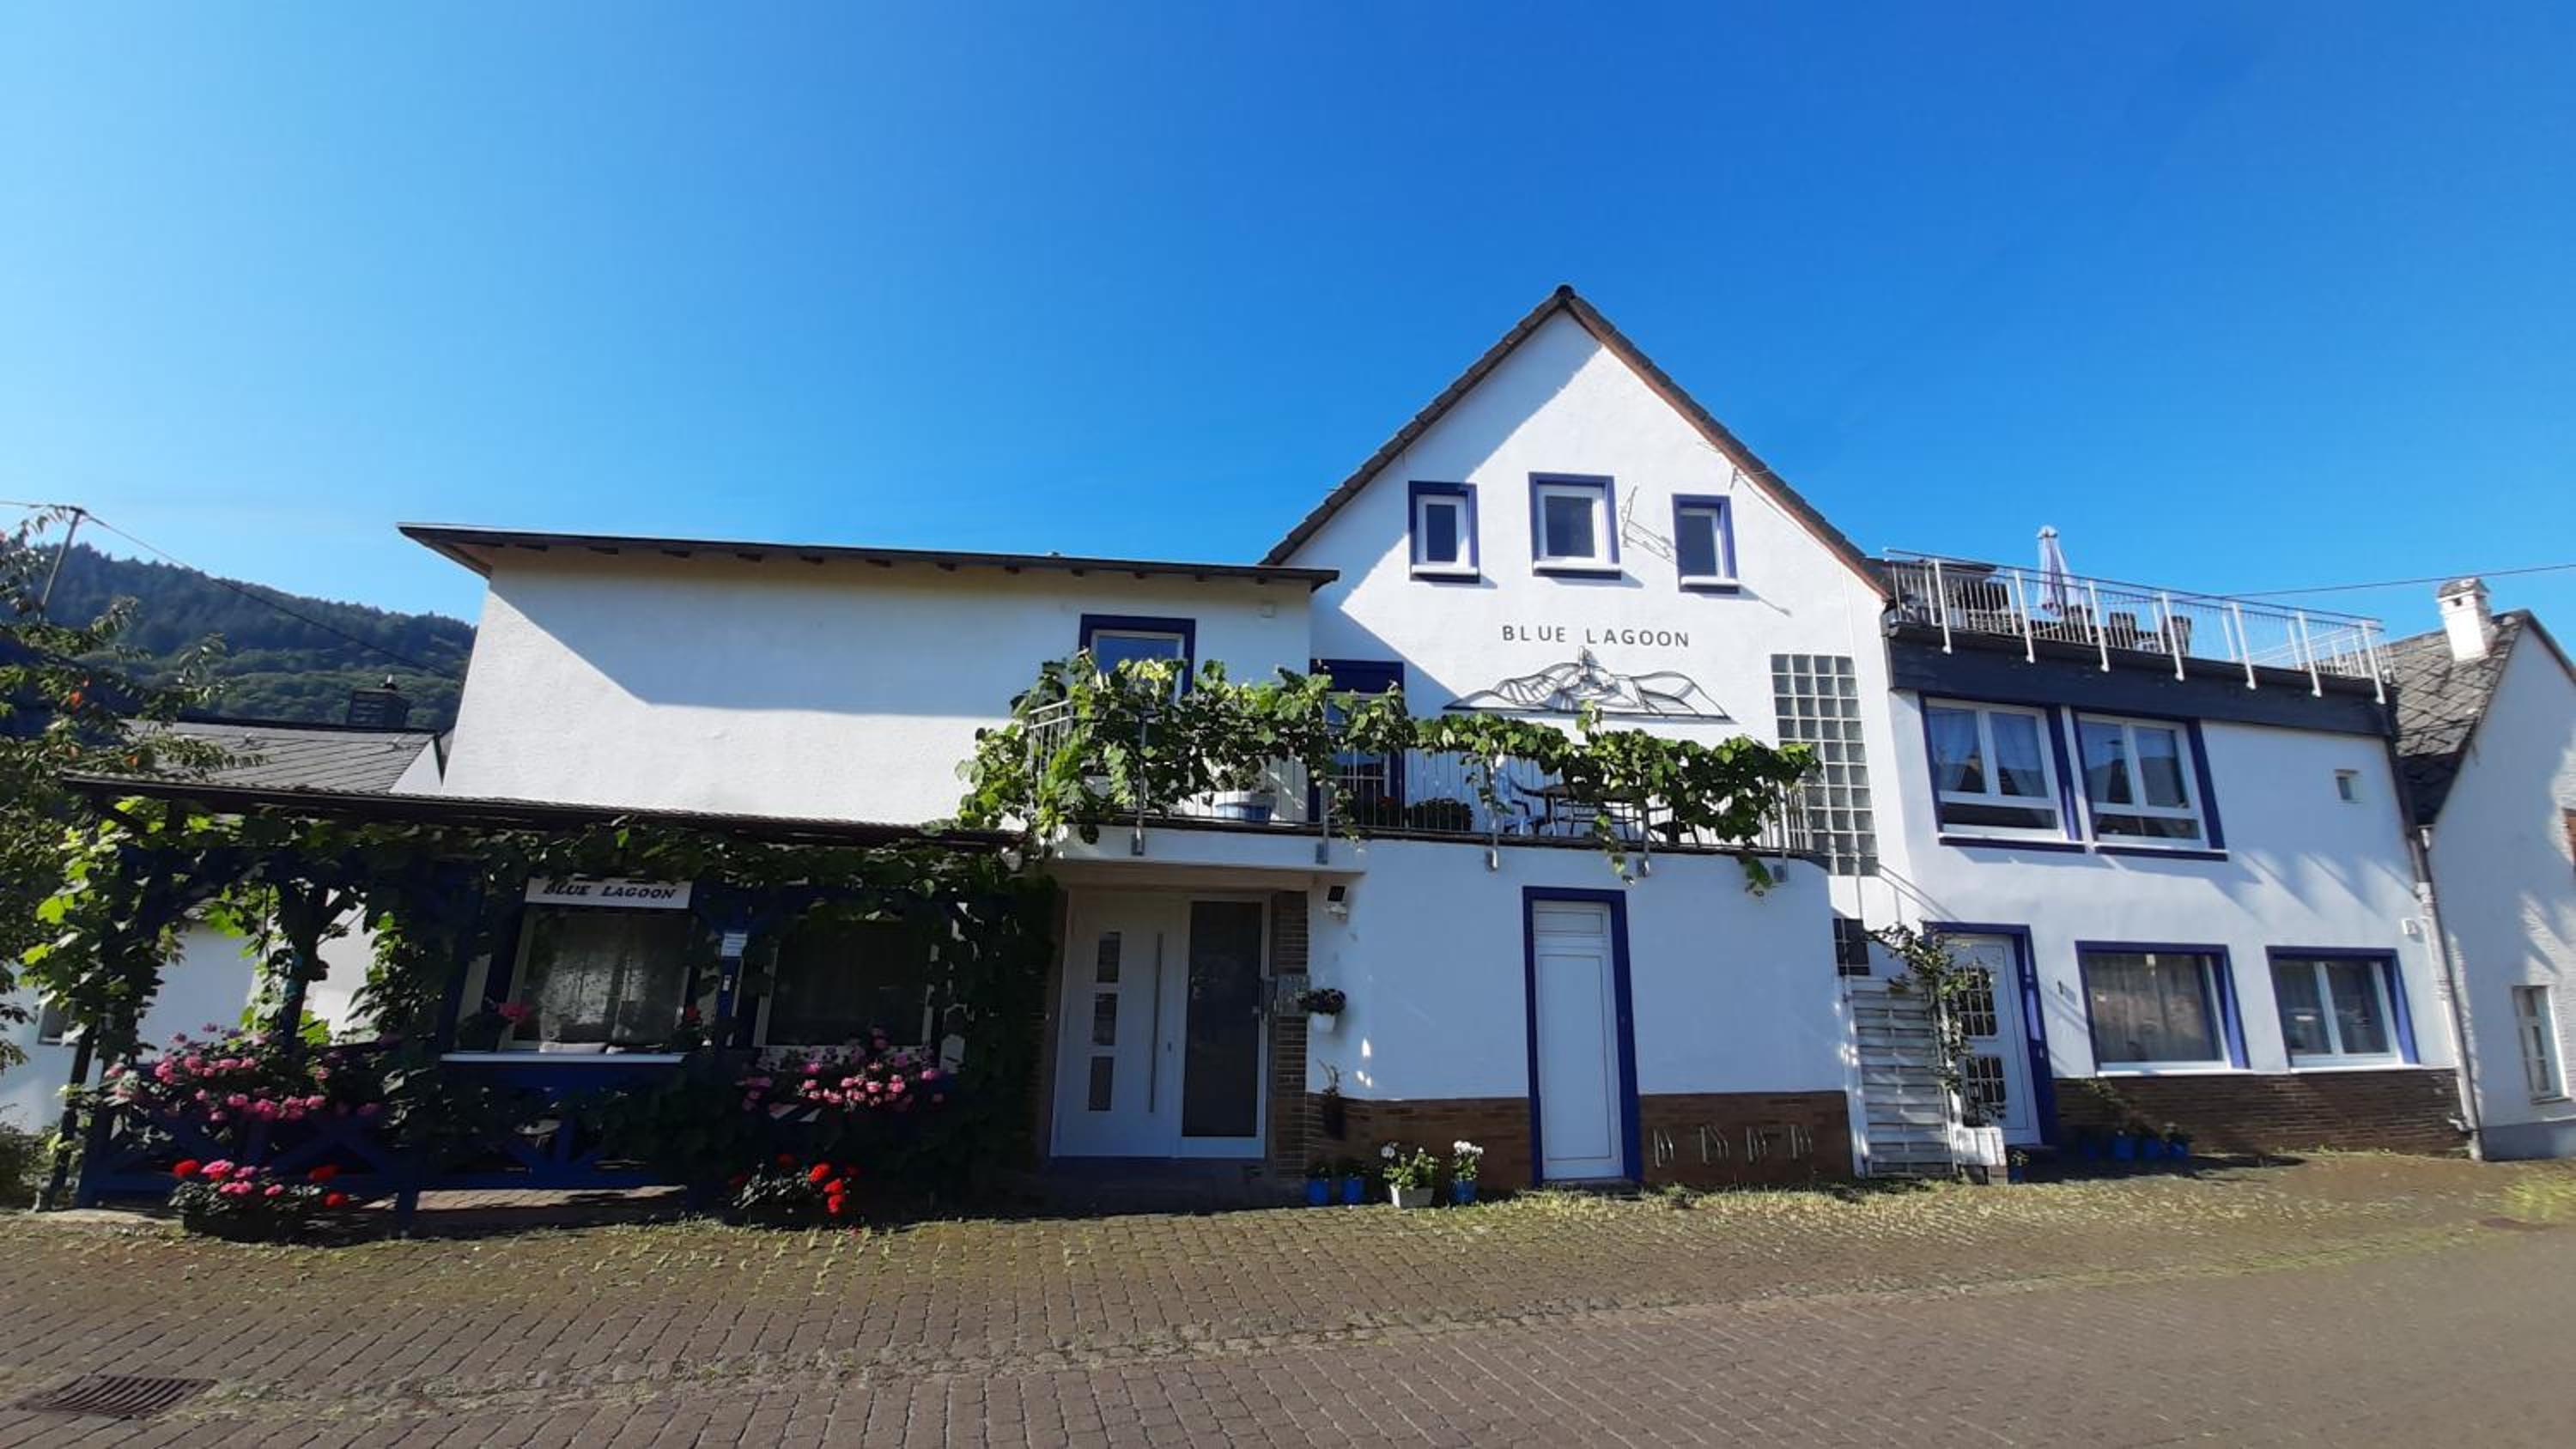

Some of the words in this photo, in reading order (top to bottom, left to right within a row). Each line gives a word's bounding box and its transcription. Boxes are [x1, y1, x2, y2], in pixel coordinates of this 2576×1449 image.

[1502, 625, 1566, 643] BLUE
[1585, 627, 1690, 648] LAGOON
[602, 885, 677, 899] LAGOON
